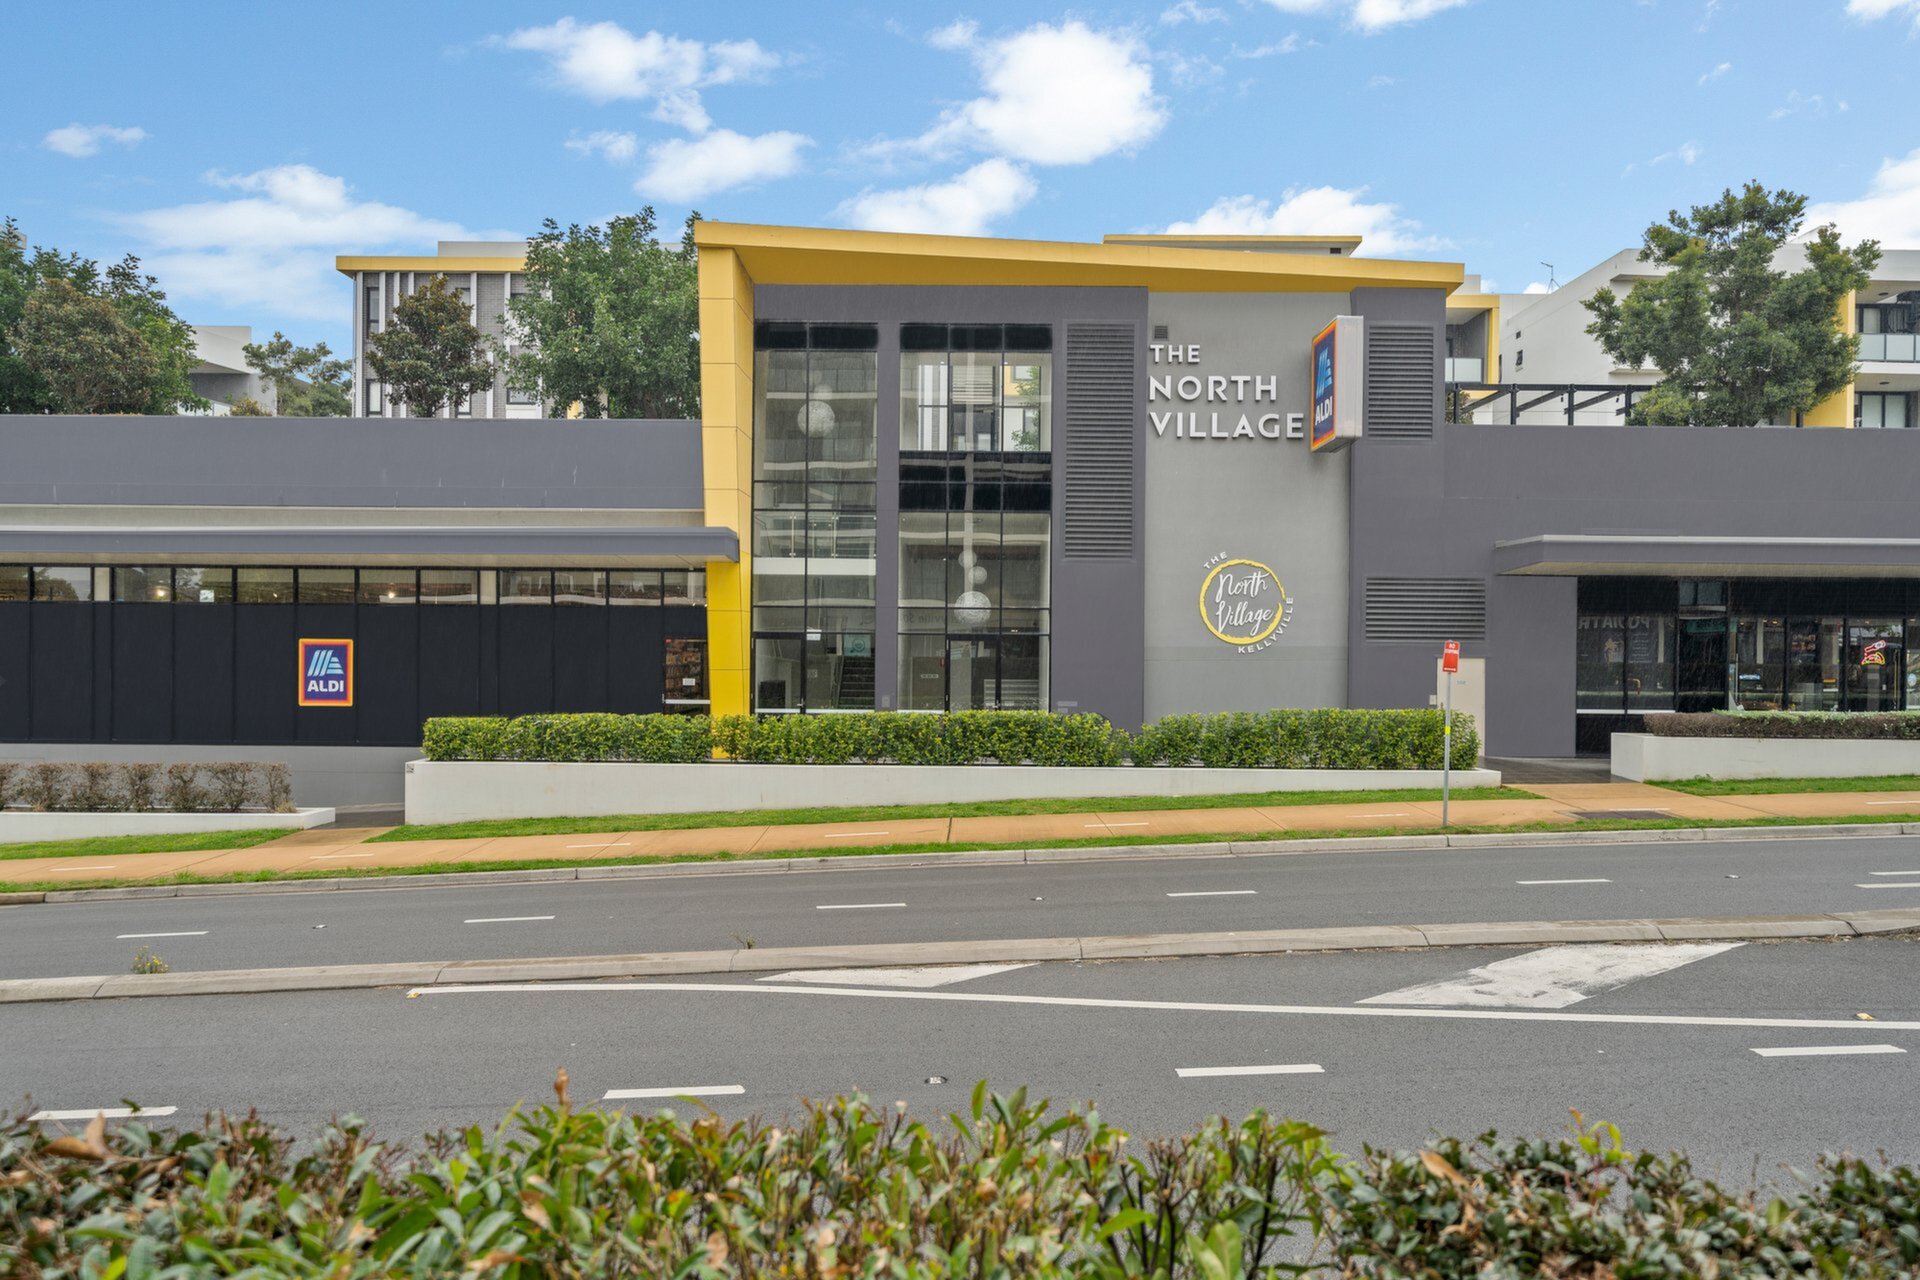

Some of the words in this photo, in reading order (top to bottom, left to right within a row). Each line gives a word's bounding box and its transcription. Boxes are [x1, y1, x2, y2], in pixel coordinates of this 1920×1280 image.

[1149, 344, 1201, 363] THE
[1149, 375, 1277, 401] NORTH
[1314, 395, 1333, 426] ALDI
[1149, 412, 1304, 438] VILLAGE
[1203, 551, 1228, 570] THE
[1215, 571, 1270, 603] North
[1215, 600, 1274, 636] Village
[1237, 597, 1294, 654] KELLYVILLE
[307, 680, 344, 692] ALDI
